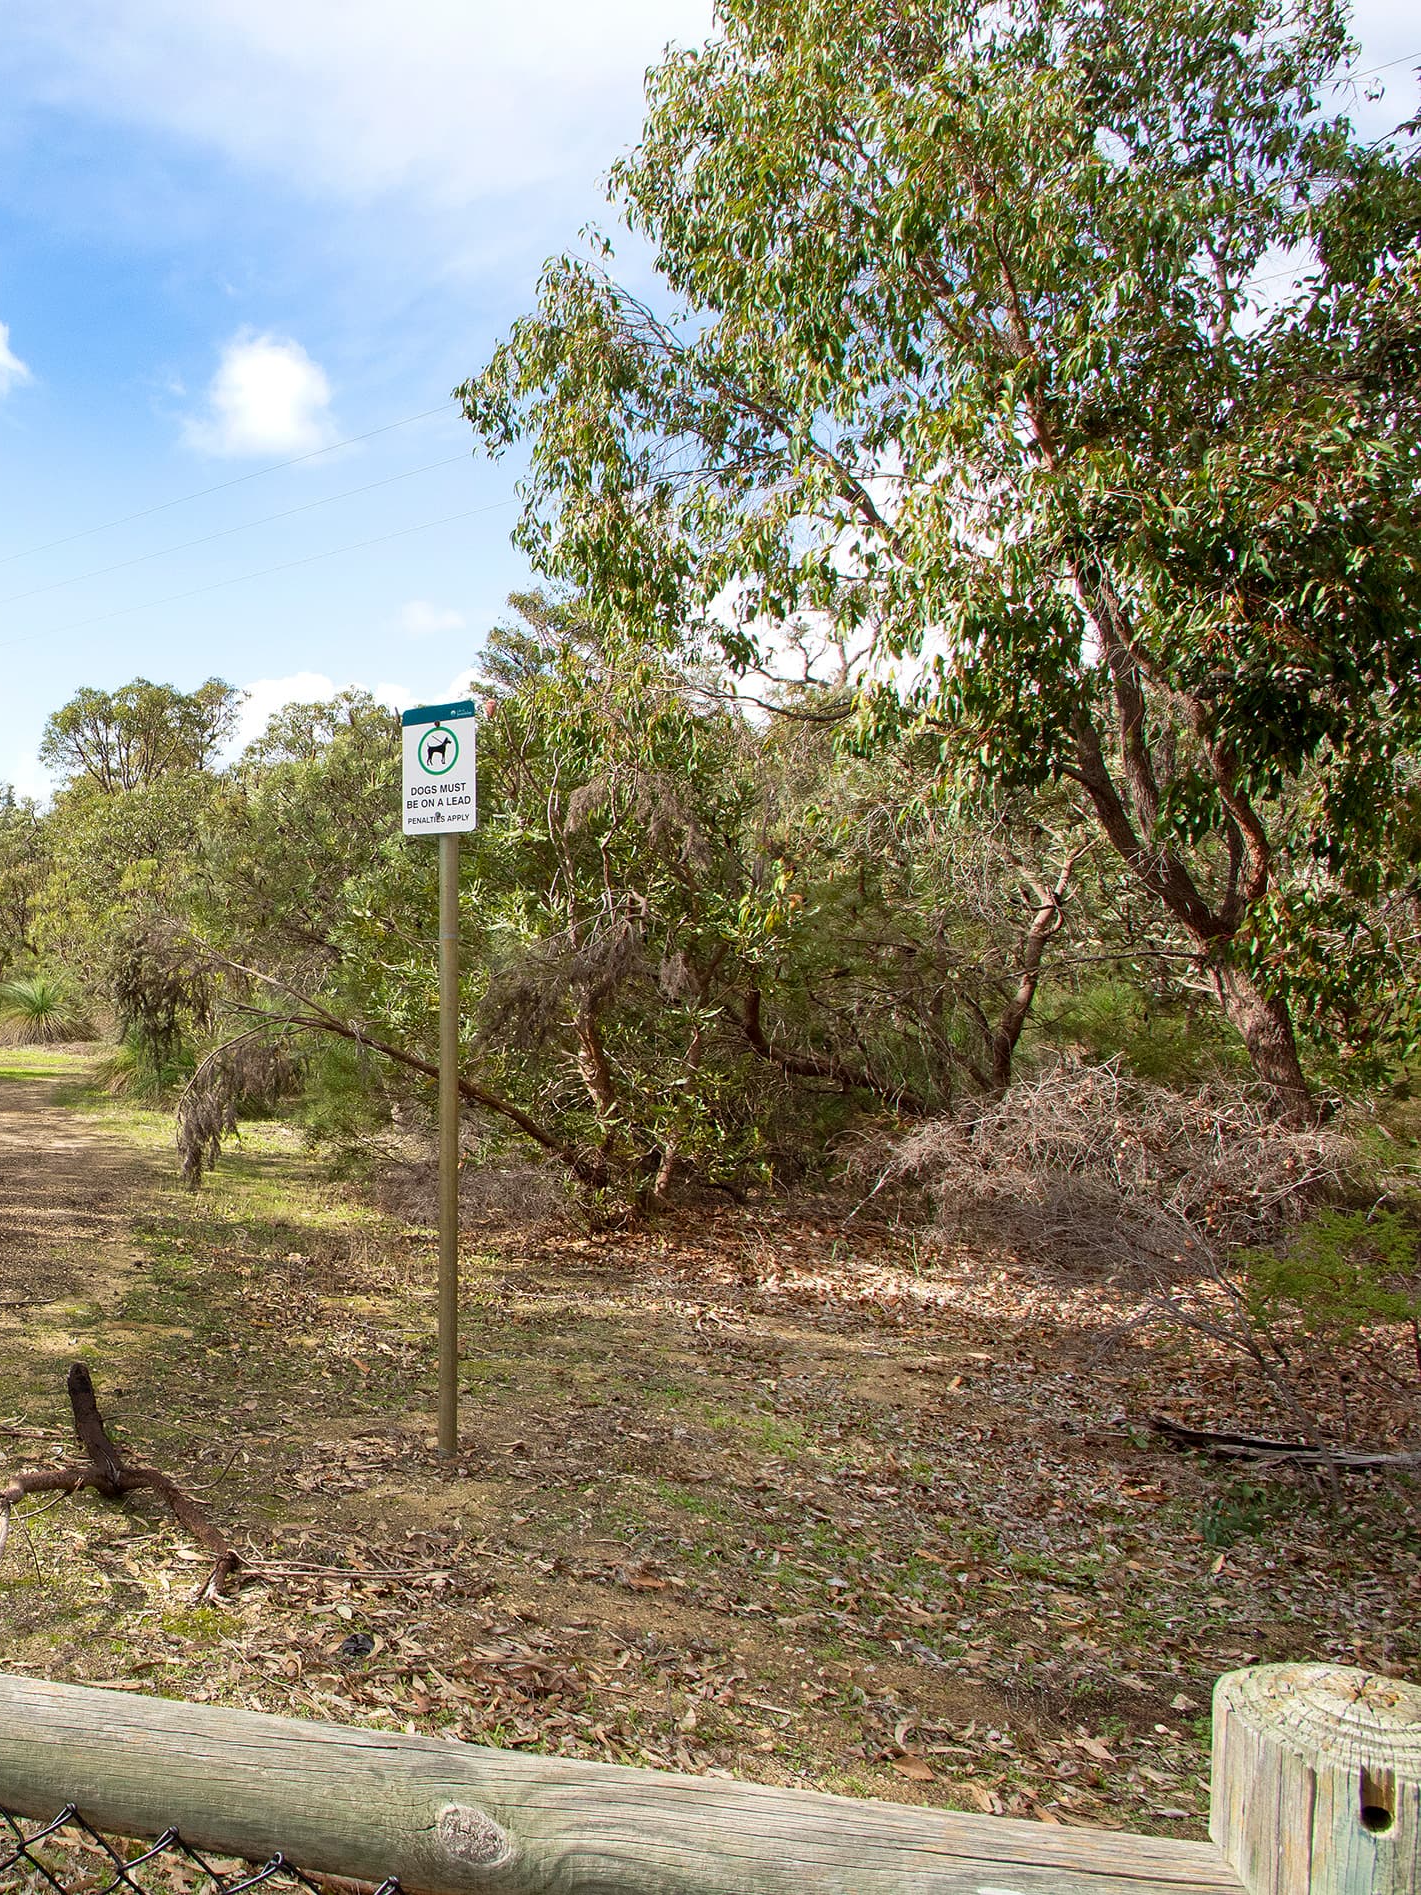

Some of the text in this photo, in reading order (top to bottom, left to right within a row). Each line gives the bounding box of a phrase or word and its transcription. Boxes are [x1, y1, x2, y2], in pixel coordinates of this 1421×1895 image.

[410, 782, 466, 796] DOGS MUST
[406, 796, 471, 809] BE ON A LEAD
[447, 814, 470, 822] APPLY
